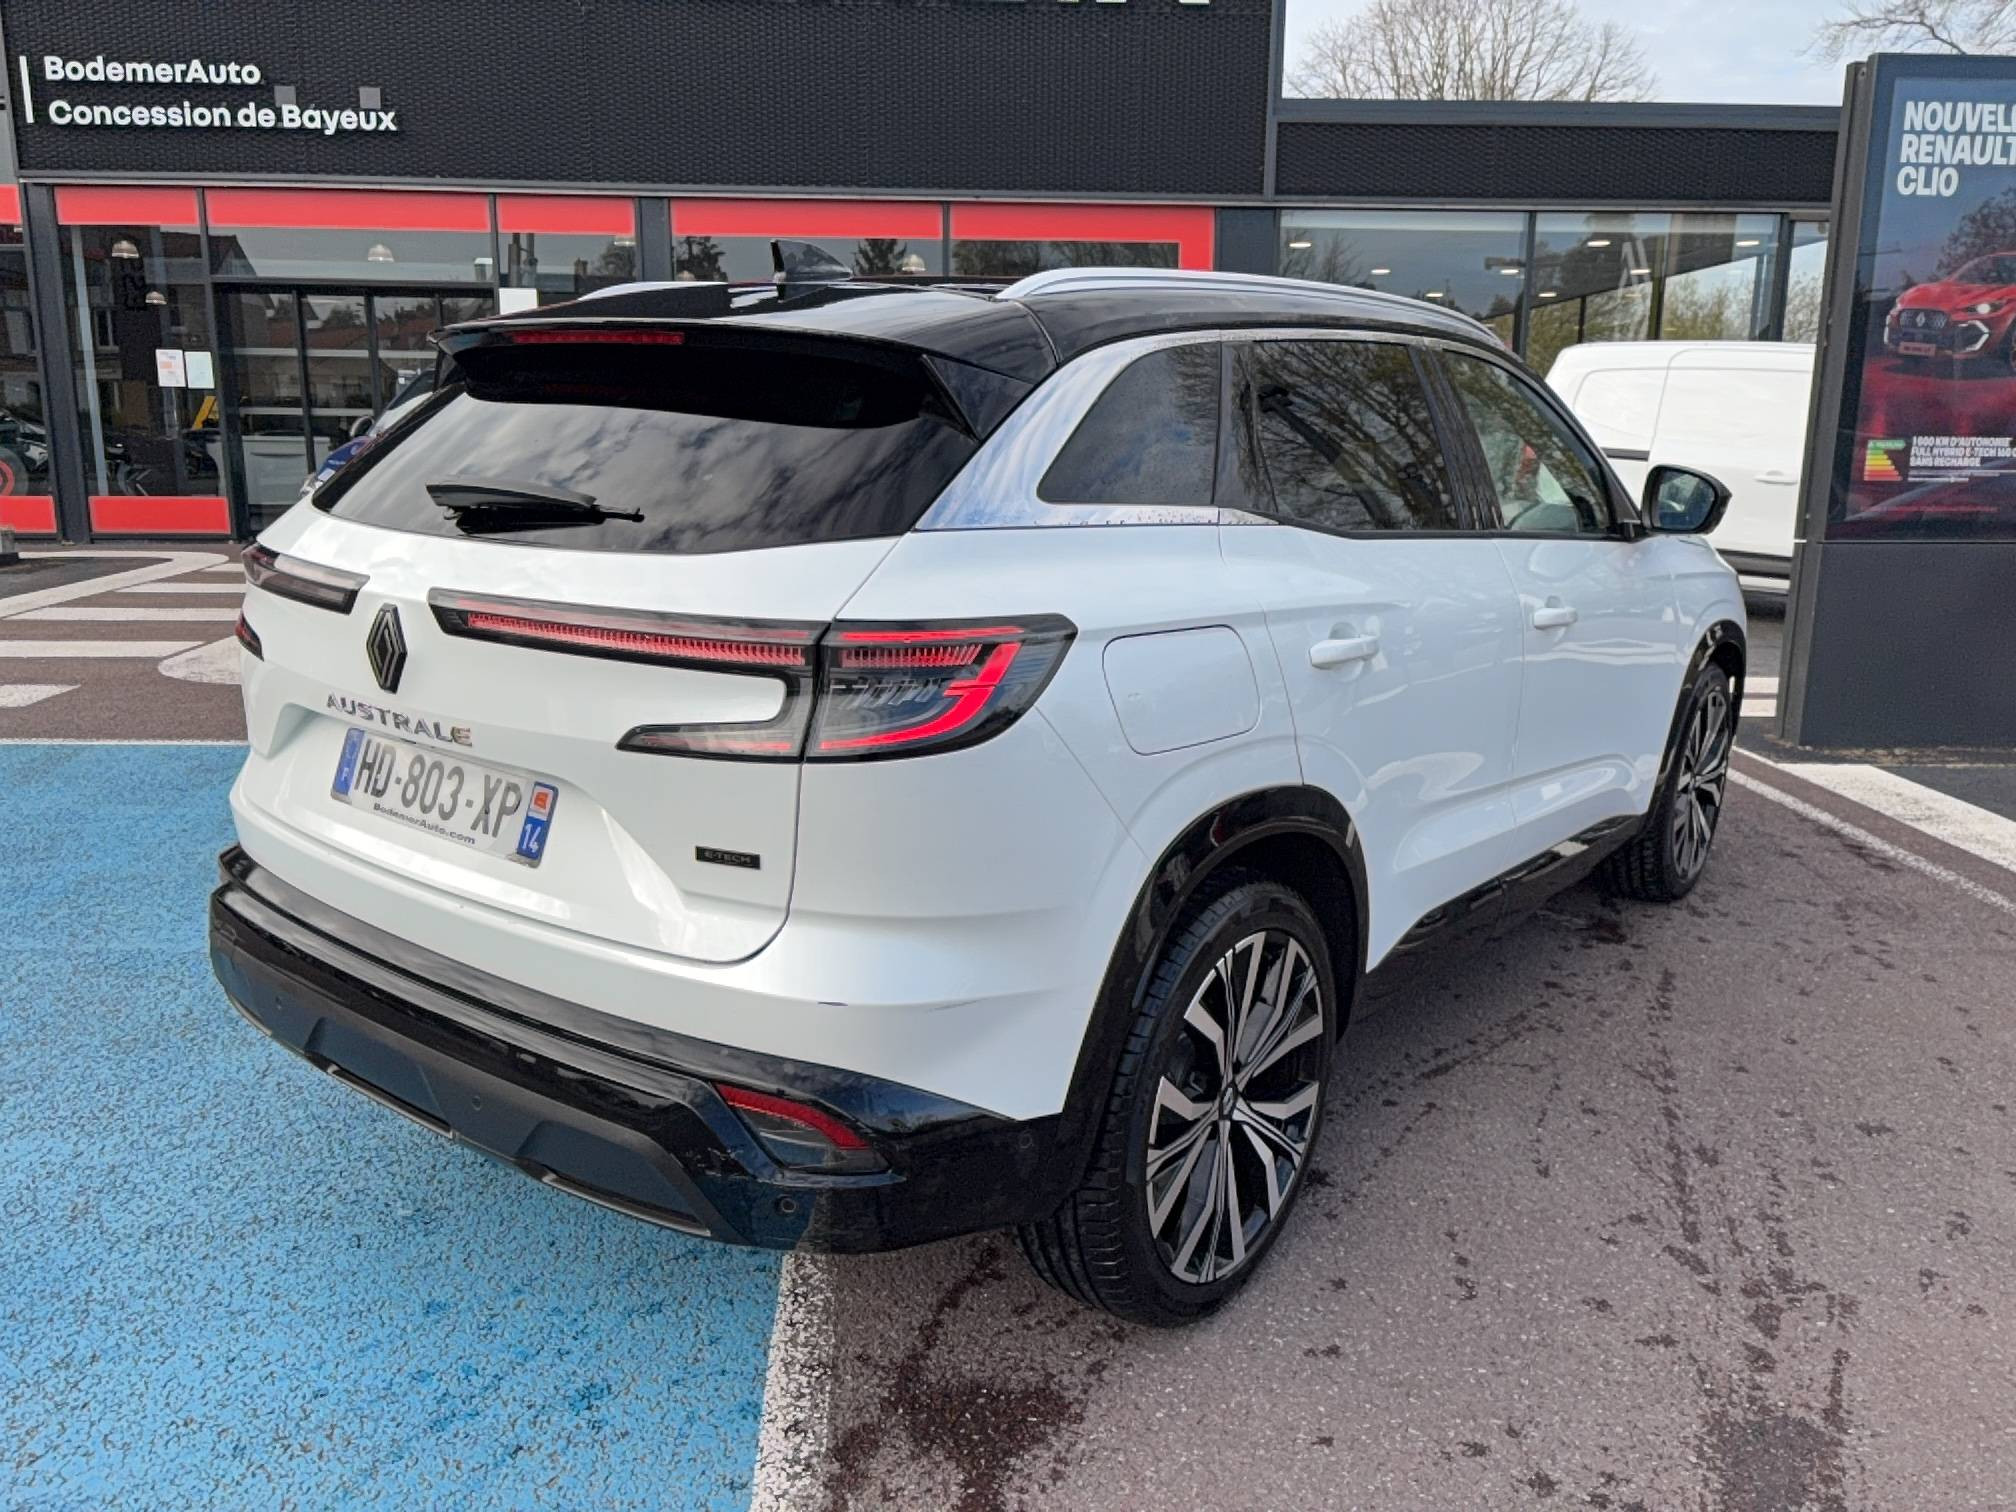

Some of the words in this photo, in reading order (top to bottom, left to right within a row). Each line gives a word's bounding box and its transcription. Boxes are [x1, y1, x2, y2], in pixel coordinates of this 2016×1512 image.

[44, 56, 261, 85] BodemerAuto
[50, 101, 232, 126] Concession
[237, 103, 276, 128] de
[282, 104, 398, 135] Bayeux
[1900, 133, 2016, 165] RENAULT
[1897, 166, 1959, 197] CLIO
[326, 693, 473, 747] AUSTRALE
[373, 802, 476, 845] BodemerAuto.com
[523, 823, 542, 854] 14
